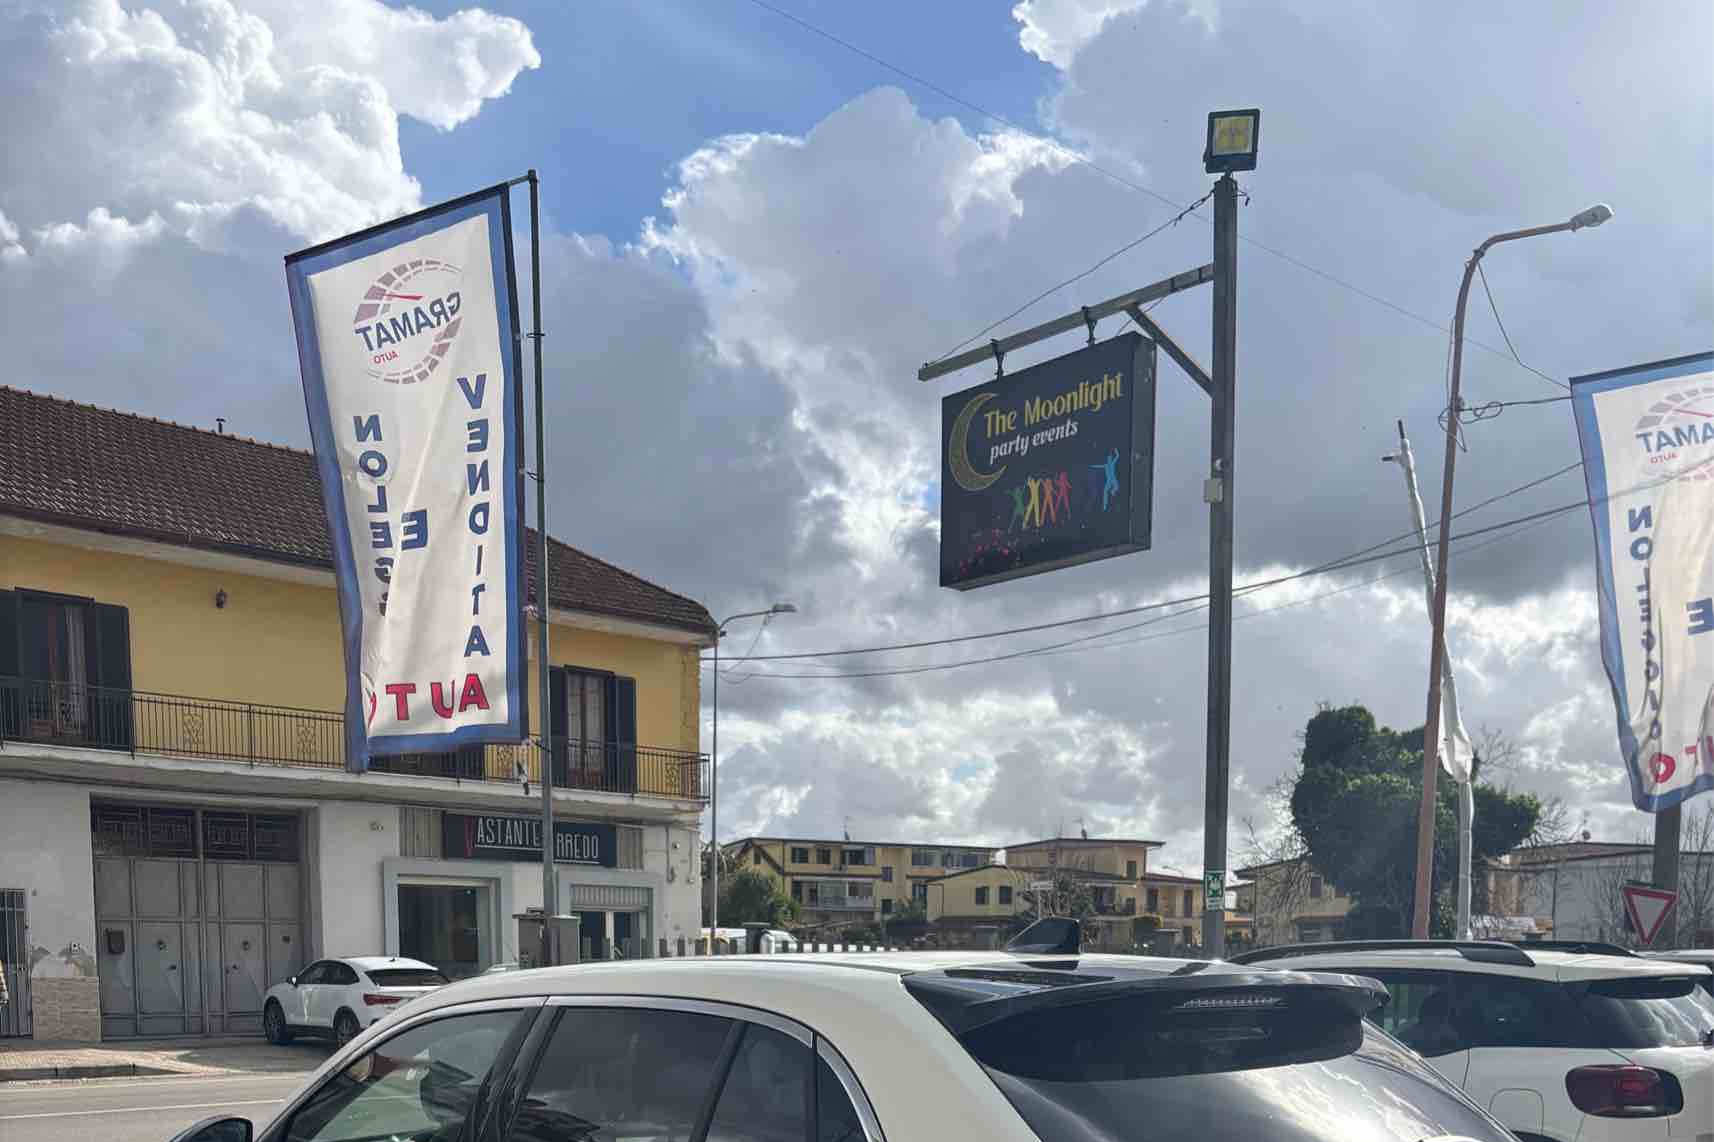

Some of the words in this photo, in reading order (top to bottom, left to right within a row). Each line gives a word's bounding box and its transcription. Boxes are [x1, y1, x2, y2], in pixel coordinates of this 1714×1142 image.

[984, 409, 1017, 438] The
[1024, 373, 1124, 428] Moonlight
[989, 433, 1030, 465] party
[1032, 420, 1079, 447] events
[553, 832, 599, 859] RREDO
